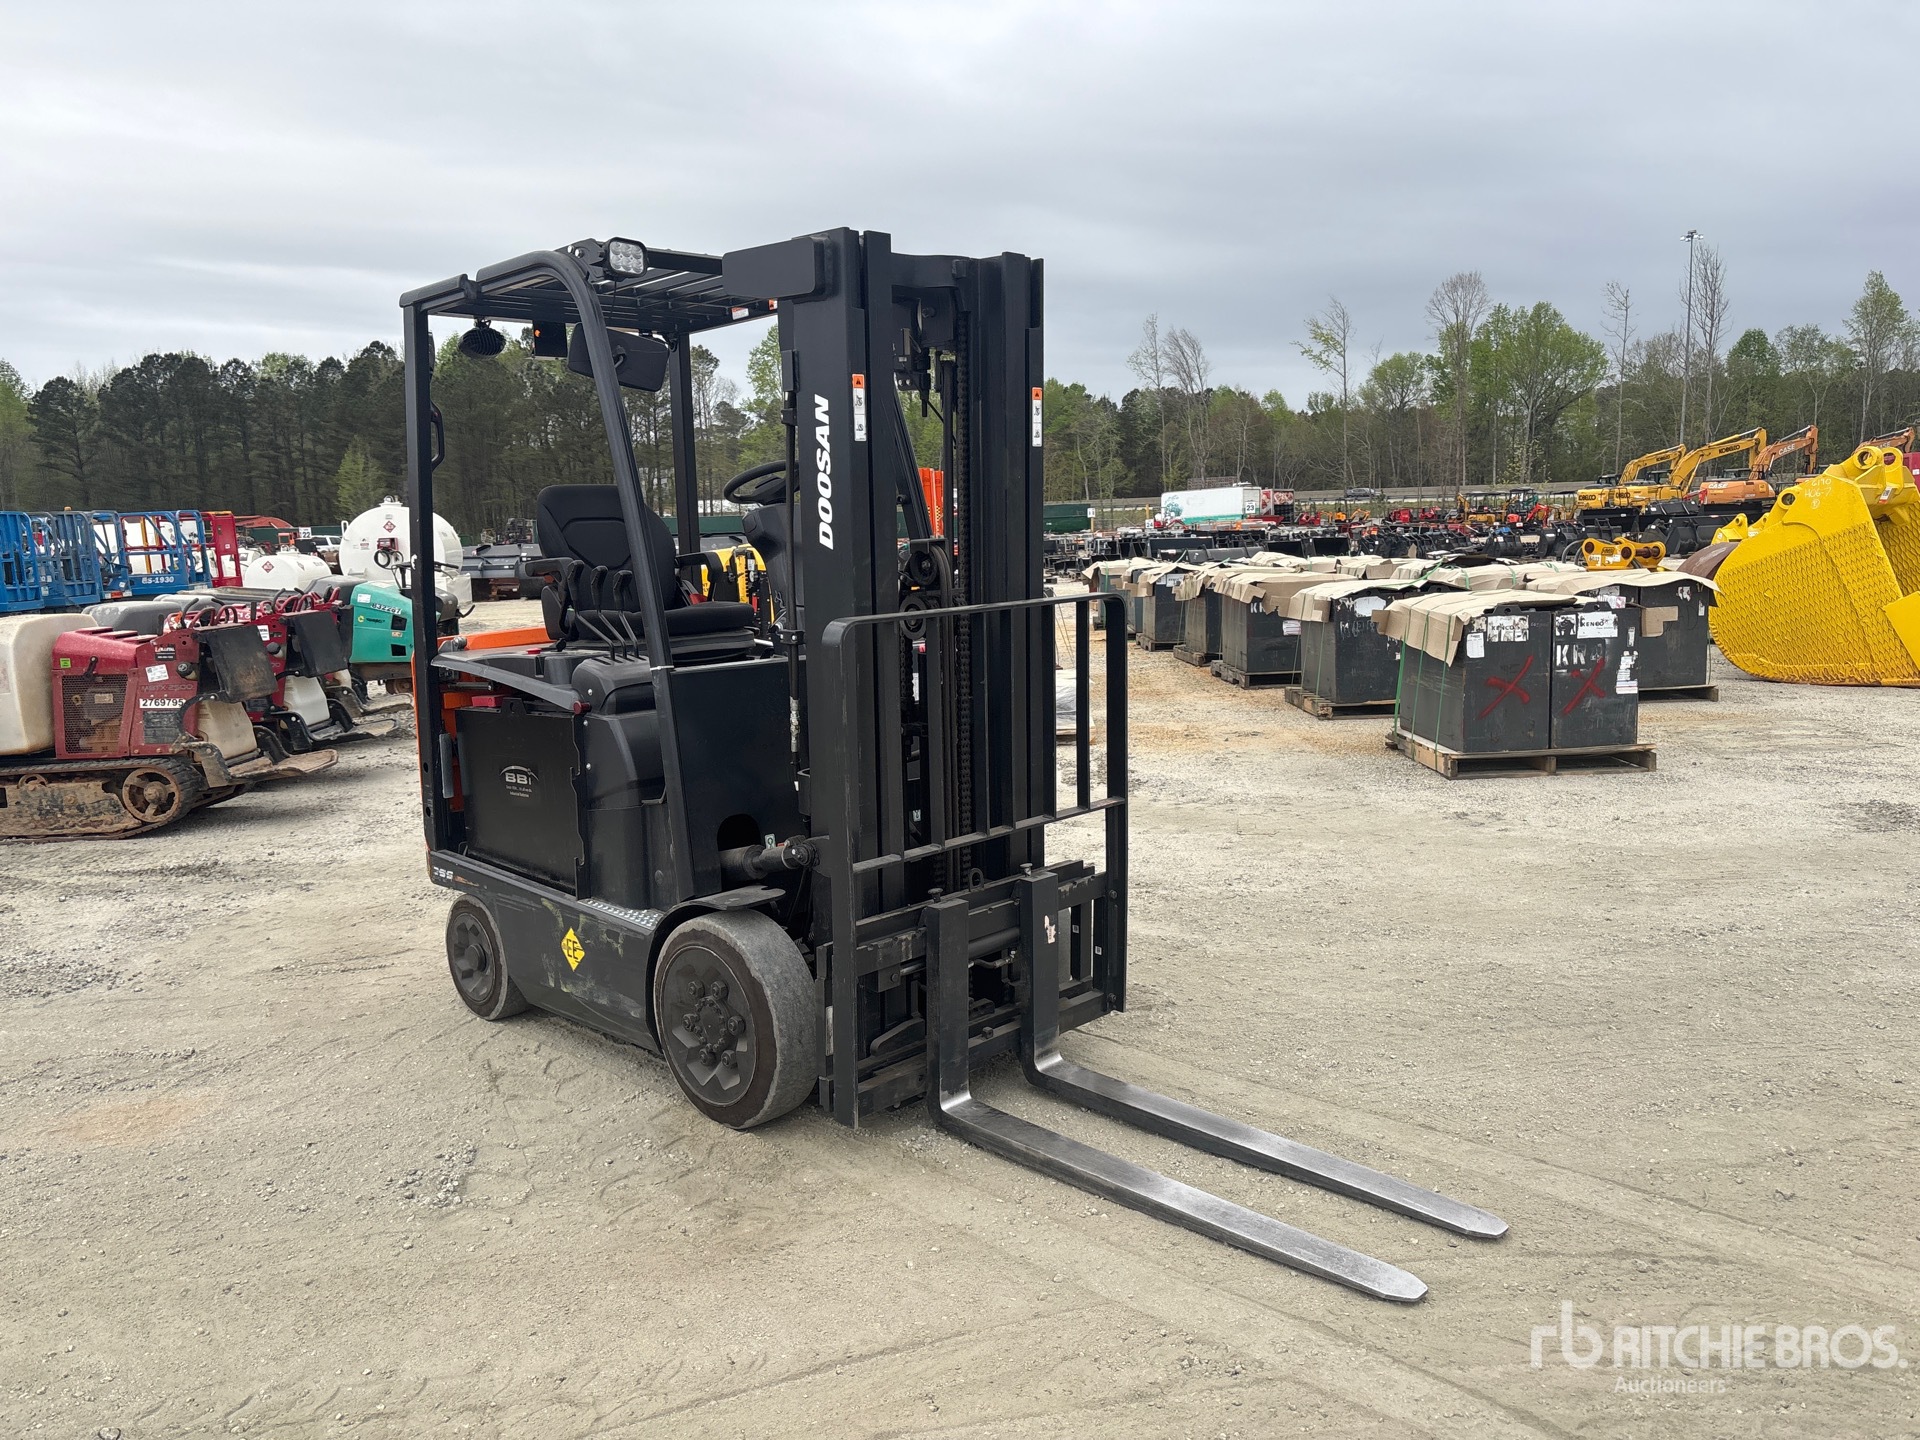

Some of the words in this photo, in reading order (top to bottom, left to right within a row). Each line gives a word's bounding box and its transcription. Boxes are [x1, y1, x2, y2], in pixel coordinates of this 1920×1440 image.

[1778, 443, 1796, 455] CASE
[814, 393, 834, 550] DOOSAN
[142, 698, 184, 707] 2769795
